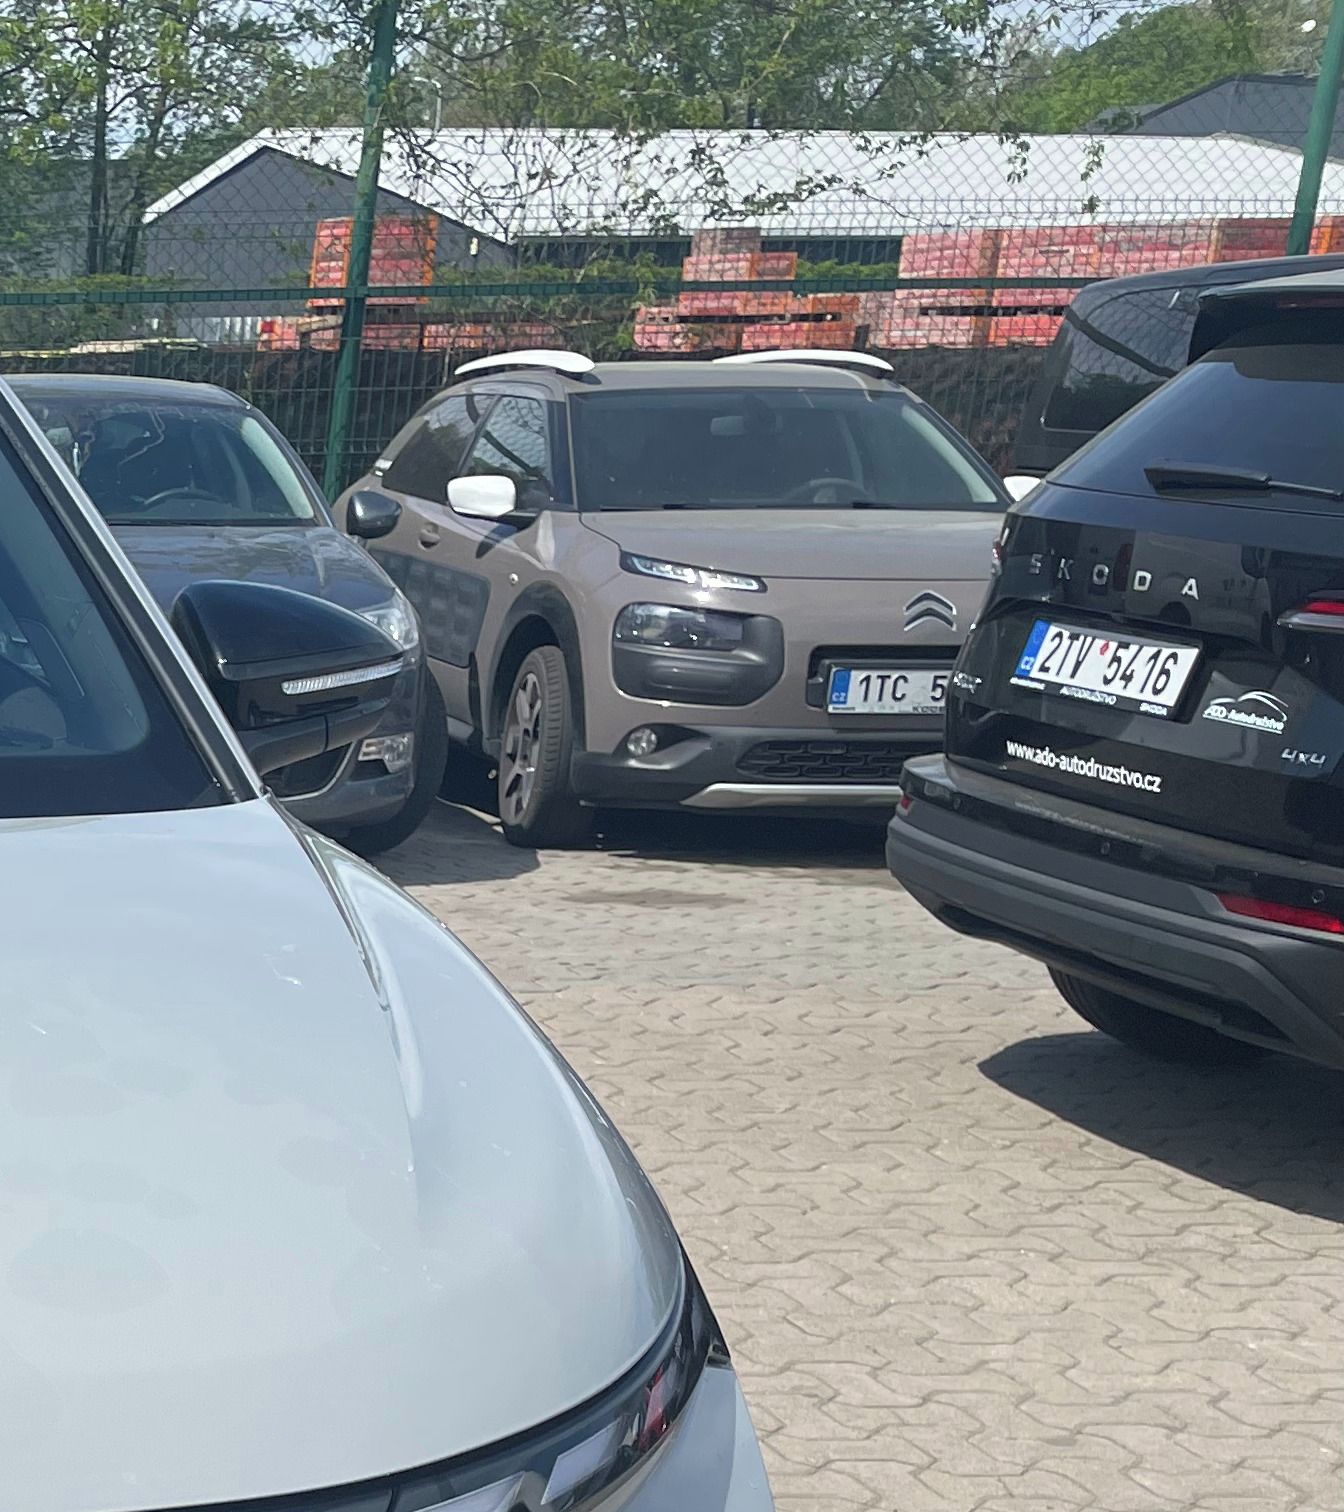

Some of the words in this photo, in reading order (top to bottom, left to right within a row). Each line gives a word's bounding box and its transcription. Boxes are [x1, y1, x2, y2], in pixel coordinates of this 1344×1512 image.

[858, 673, 910, 702] 1TC
[1037, 630, 1096, 680] 2TV
[1102, 640, 1179, 696] 5416
[1006, 740, 1162, 793] www.ado-autodruzstvo.cz
